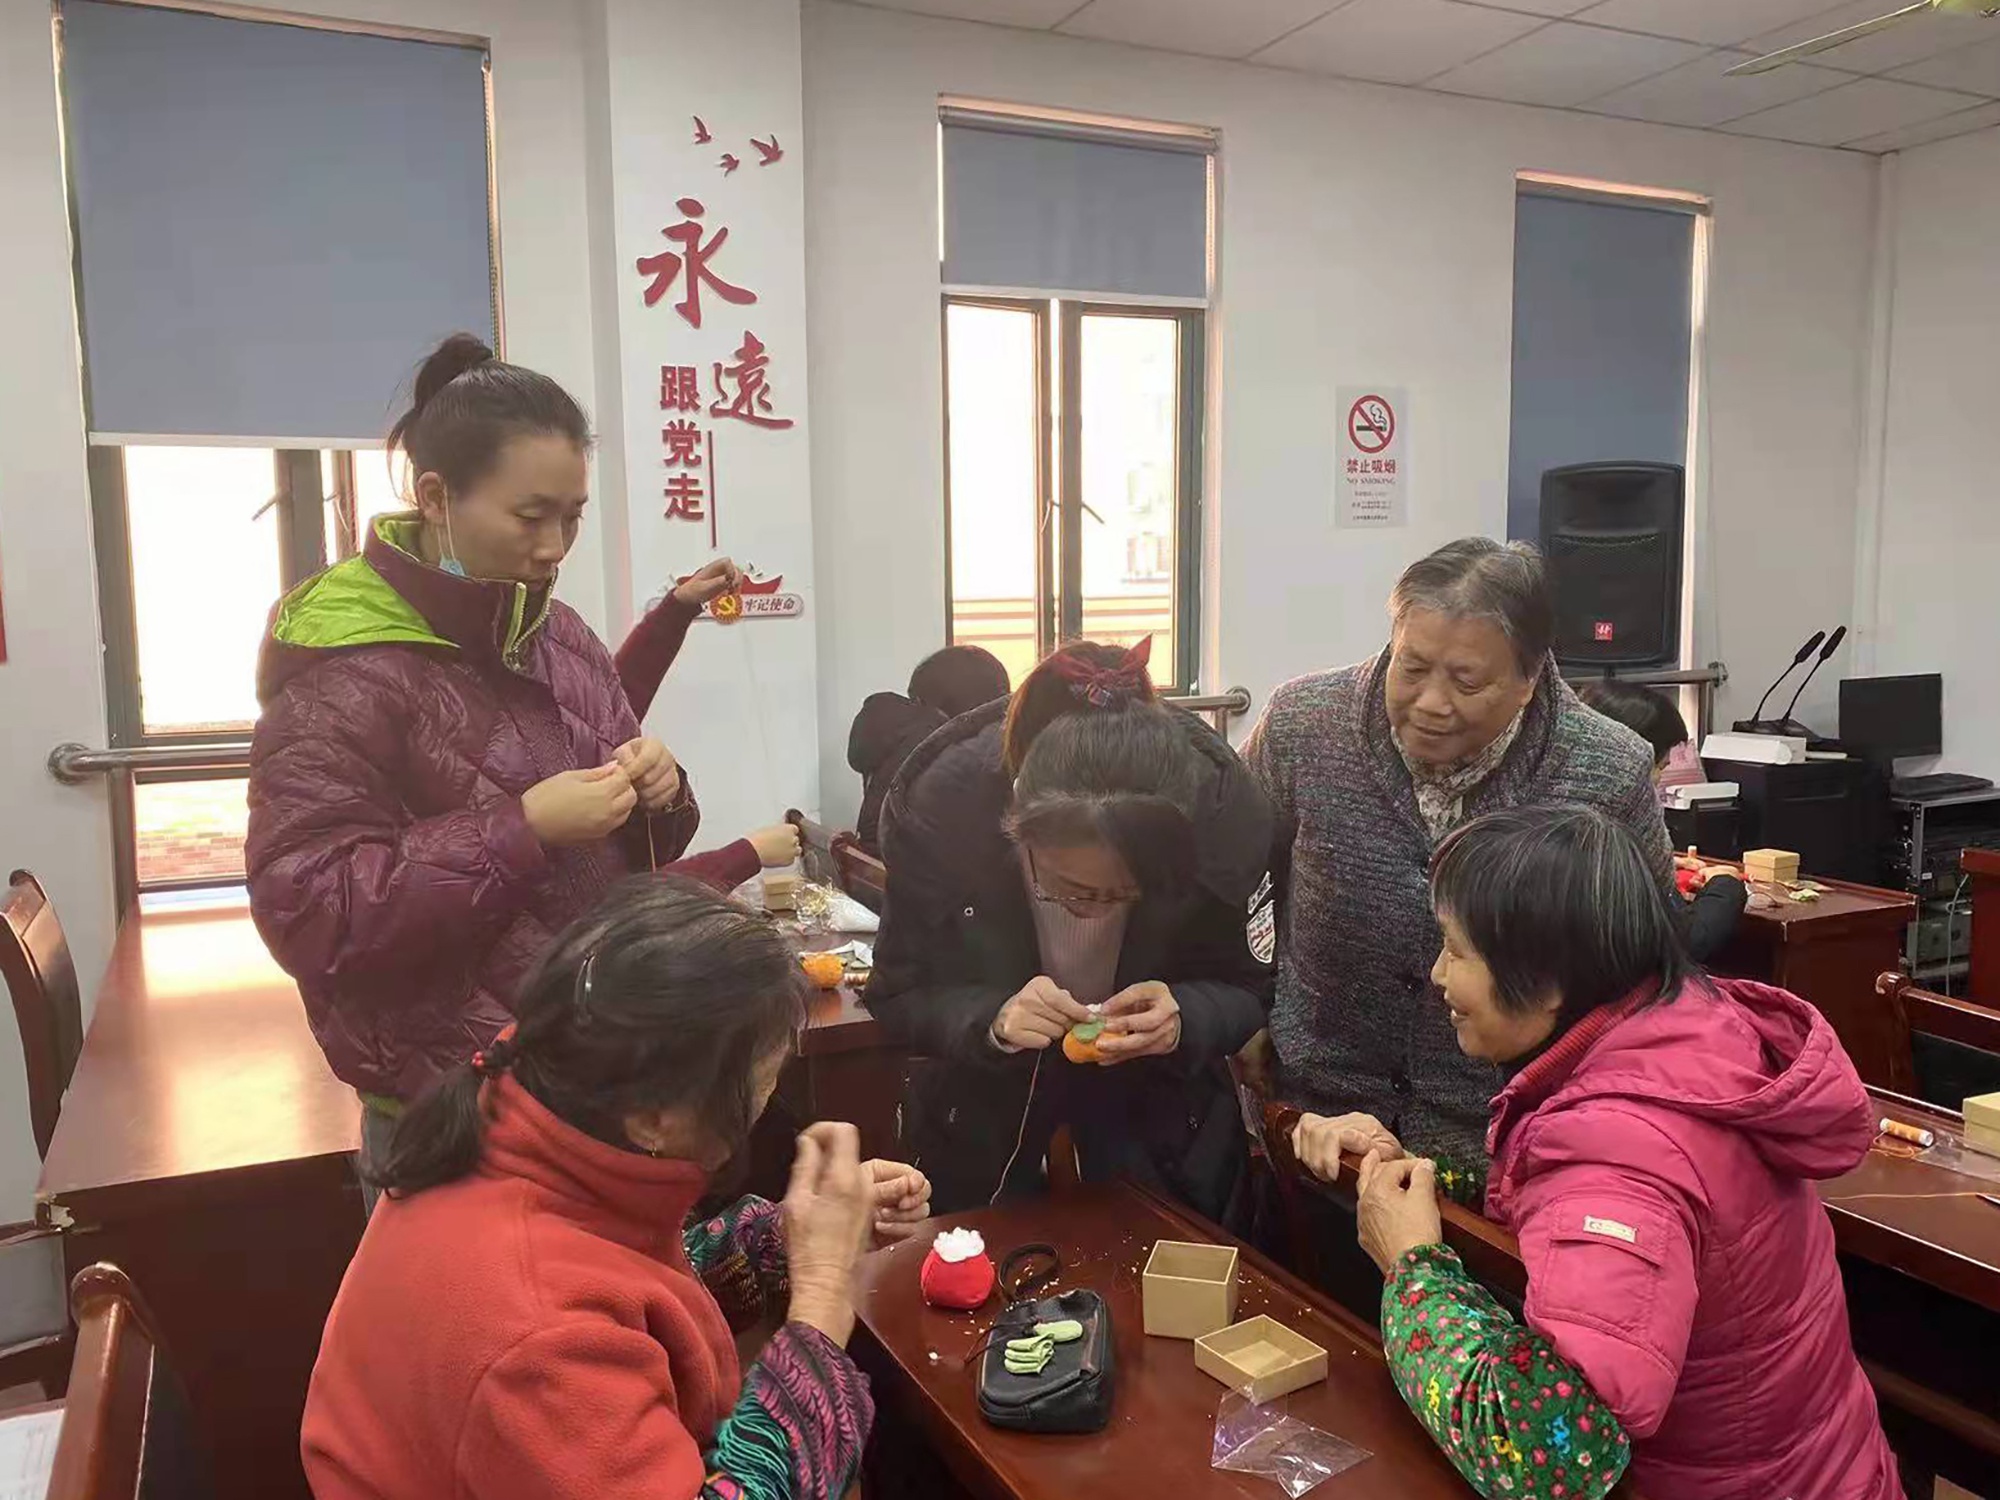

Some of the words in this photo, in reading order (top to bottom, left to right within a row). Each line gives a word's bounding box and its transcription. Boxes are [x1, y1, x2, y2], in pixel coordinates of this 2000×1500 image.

[659, 365, 705, 521] 跟党走
[1347, 459, 1396, 474] 禁止吸烟
[1347, 477, 1358, 485] NO
[1360, 477, 1396, 485] SMOKING
[745, 598, 795, 612] 牢记使命
